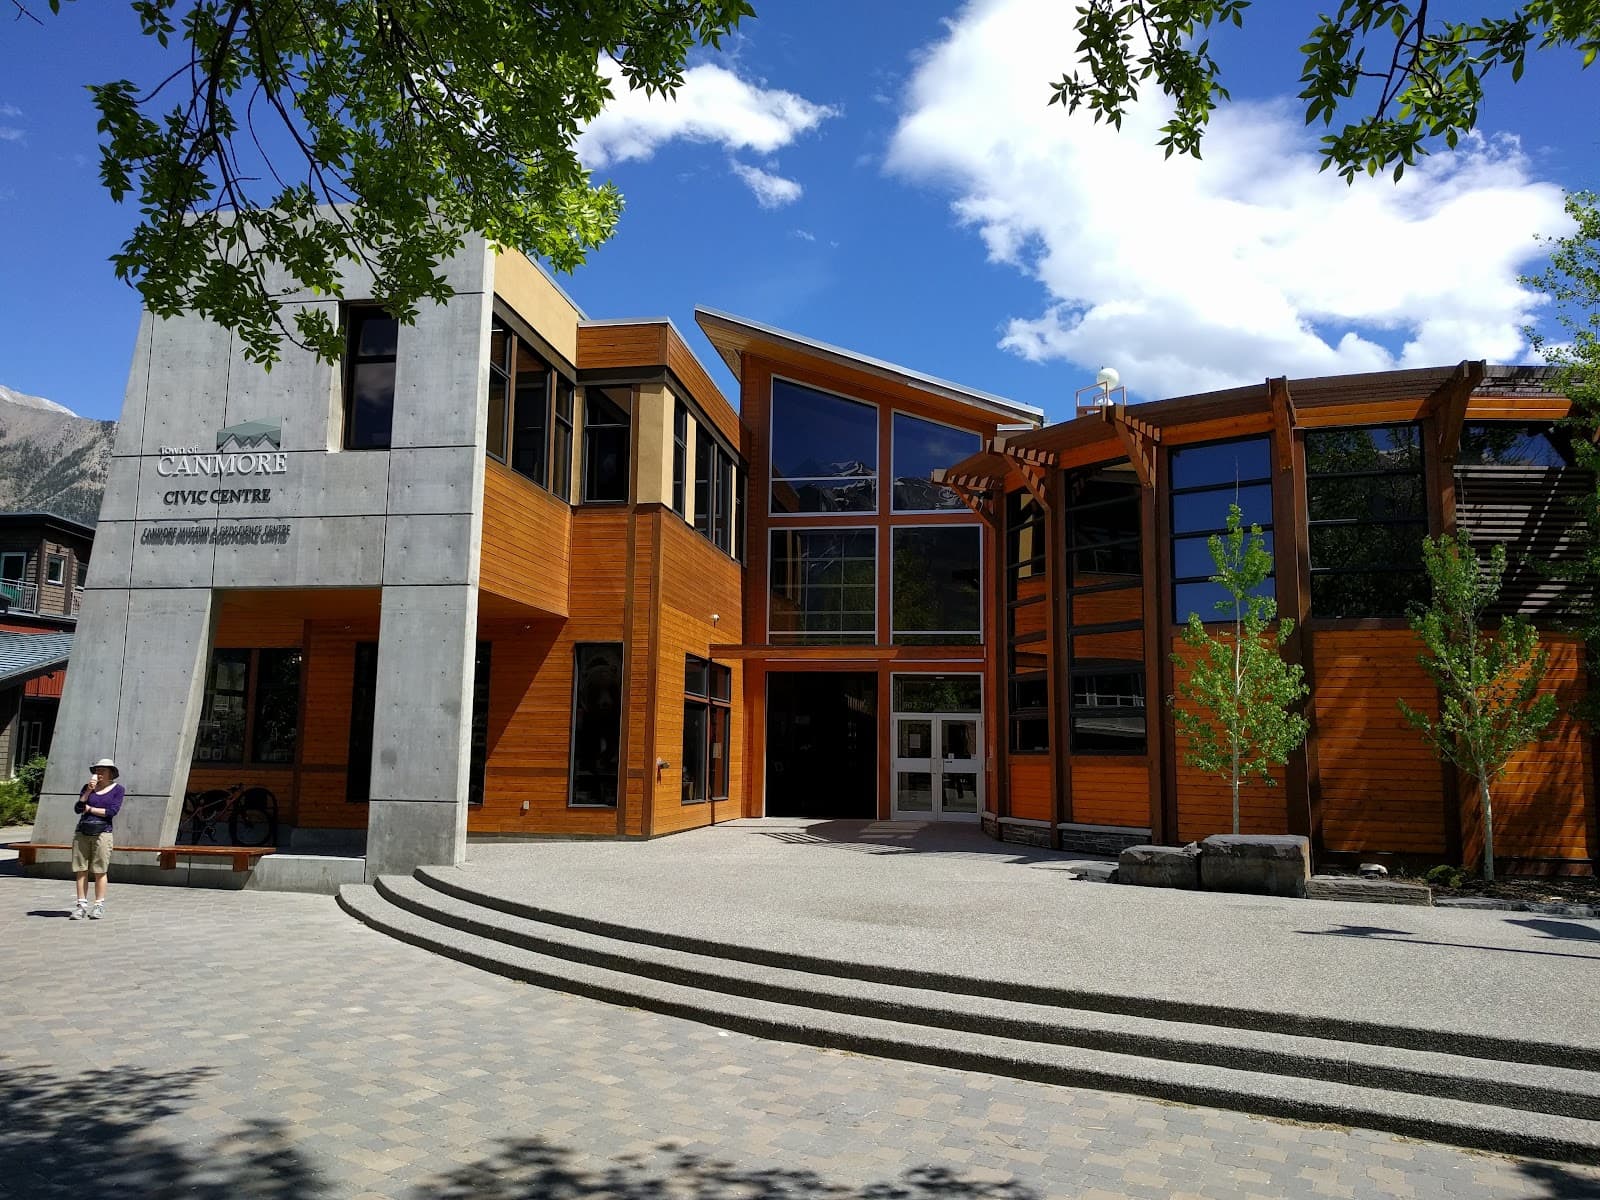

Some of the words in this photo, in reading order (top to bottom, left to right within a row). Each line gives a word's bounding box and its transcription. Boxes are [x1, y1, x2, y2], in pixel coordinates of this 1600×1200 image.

[158, 453, 287, 475] CANMORE
[163, 490, 208, 505] CIVIC
[210, 488, 271, 504] CENTRE
[178, 526, 209, 541] MUSEUM
[263, 524, 291, 540] CENTRE
